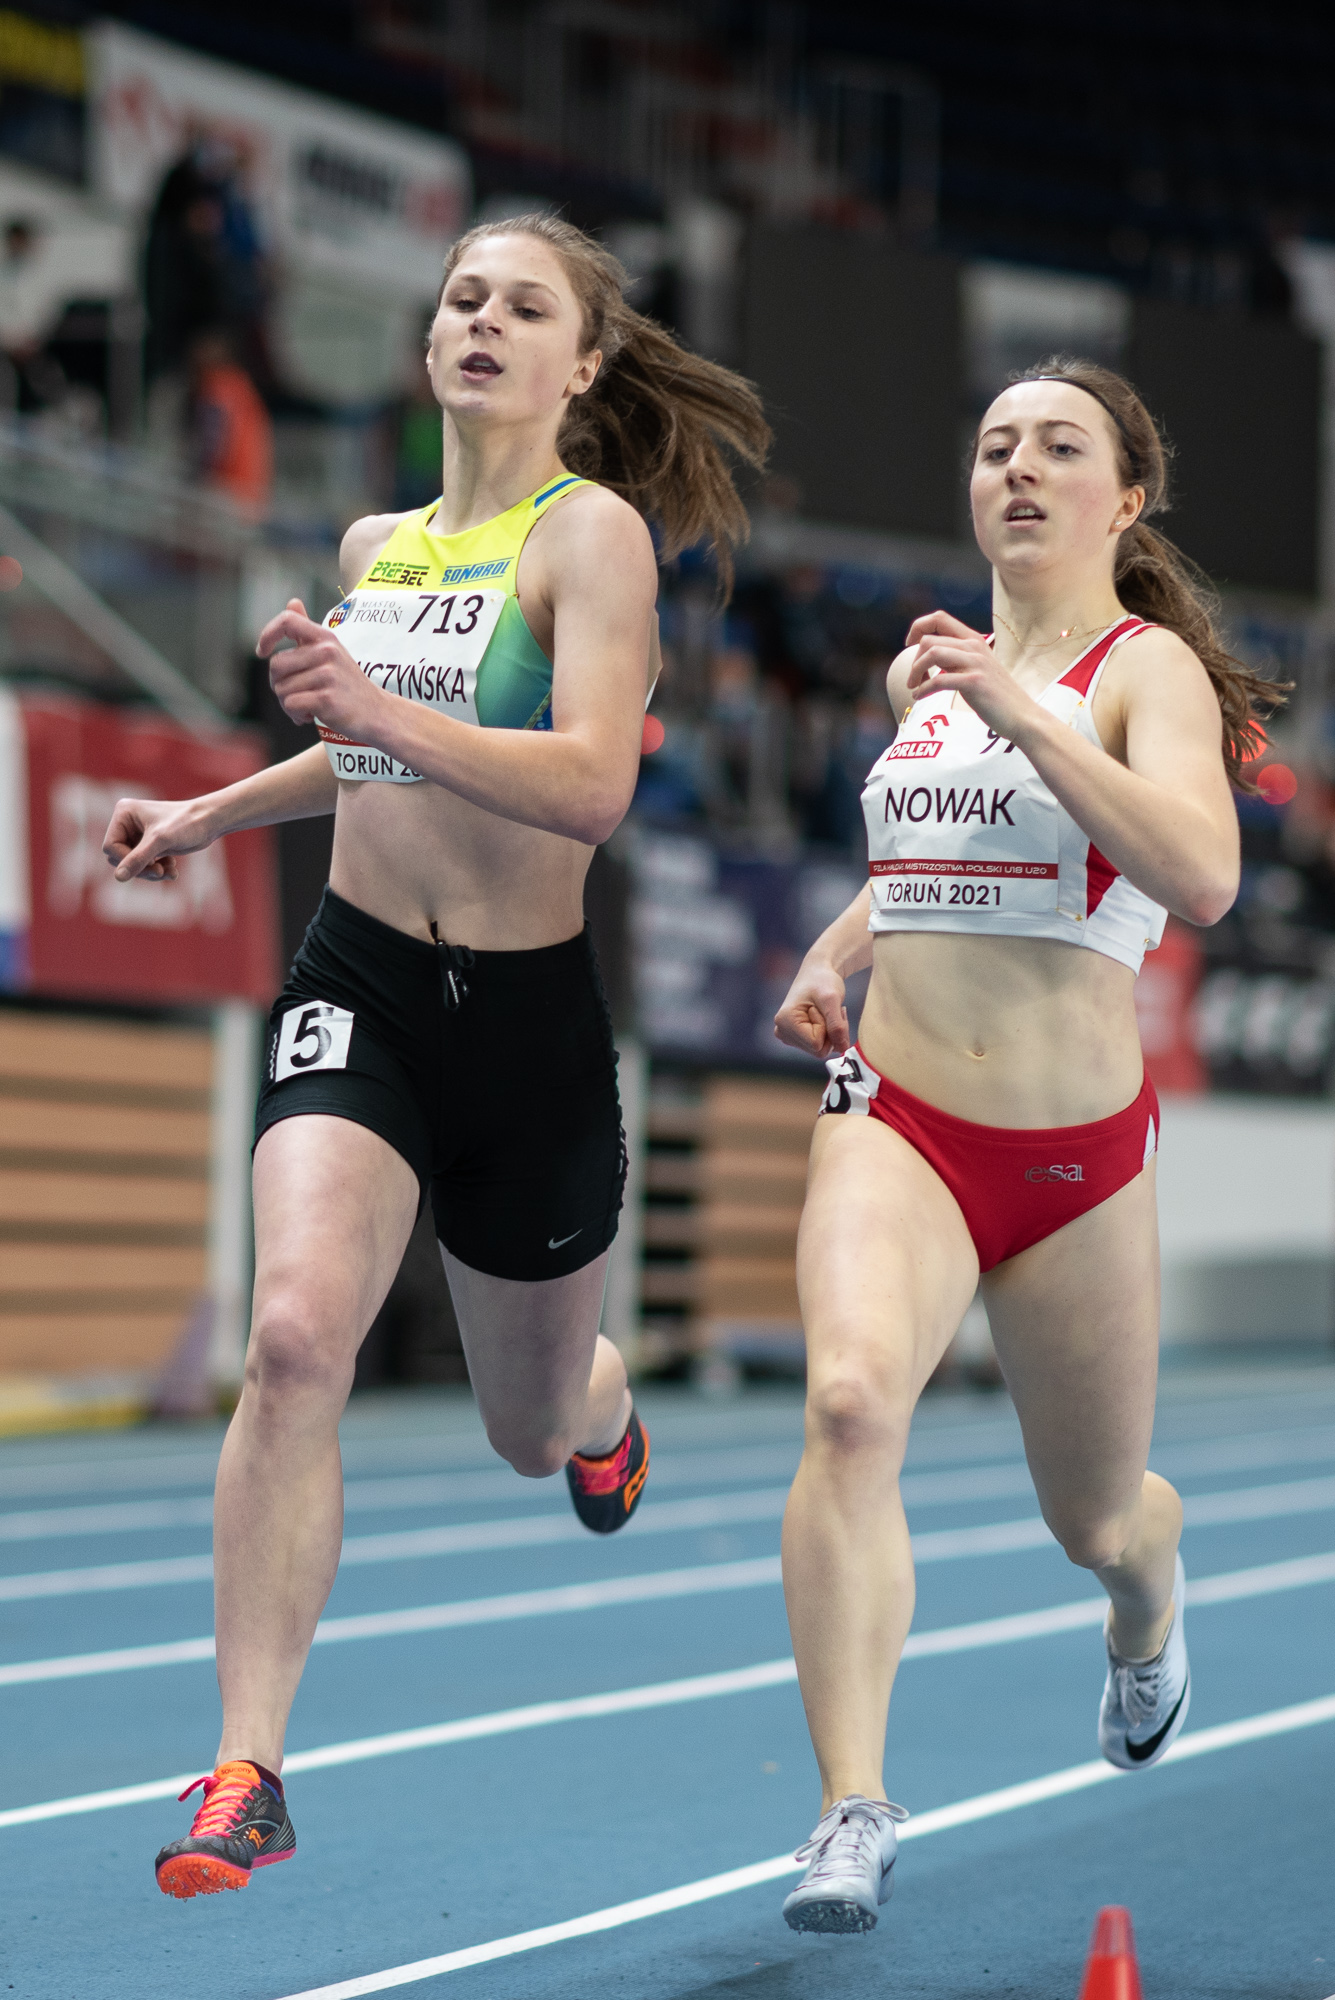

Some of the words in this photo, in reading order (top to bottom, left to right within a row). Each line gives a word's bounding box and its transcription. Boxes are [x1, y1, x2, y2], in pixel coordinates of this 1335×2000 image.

[441, 560, 511, 584] SONAROL
[354, 606, 403, 624] TORUŃ
[408, 594, 485, 635] 713
[889, 742, 940, 759] ORLEN
[884, 786, 1017, 827] NOWAK
[904, 862, 965, 872] MISTRZOSTWA
[966, 864, 1002, 874] POLSKI
[1004, 866, 1023, 874] U18
[1025, 866, 1048, 875] U20
[887, 877, 941, 904] TORUŃ
[948, 884, 1002, 906] 2021
[289, 1006, 335, 1069] 5
[1024, 1163, 1086, 1183] esa
